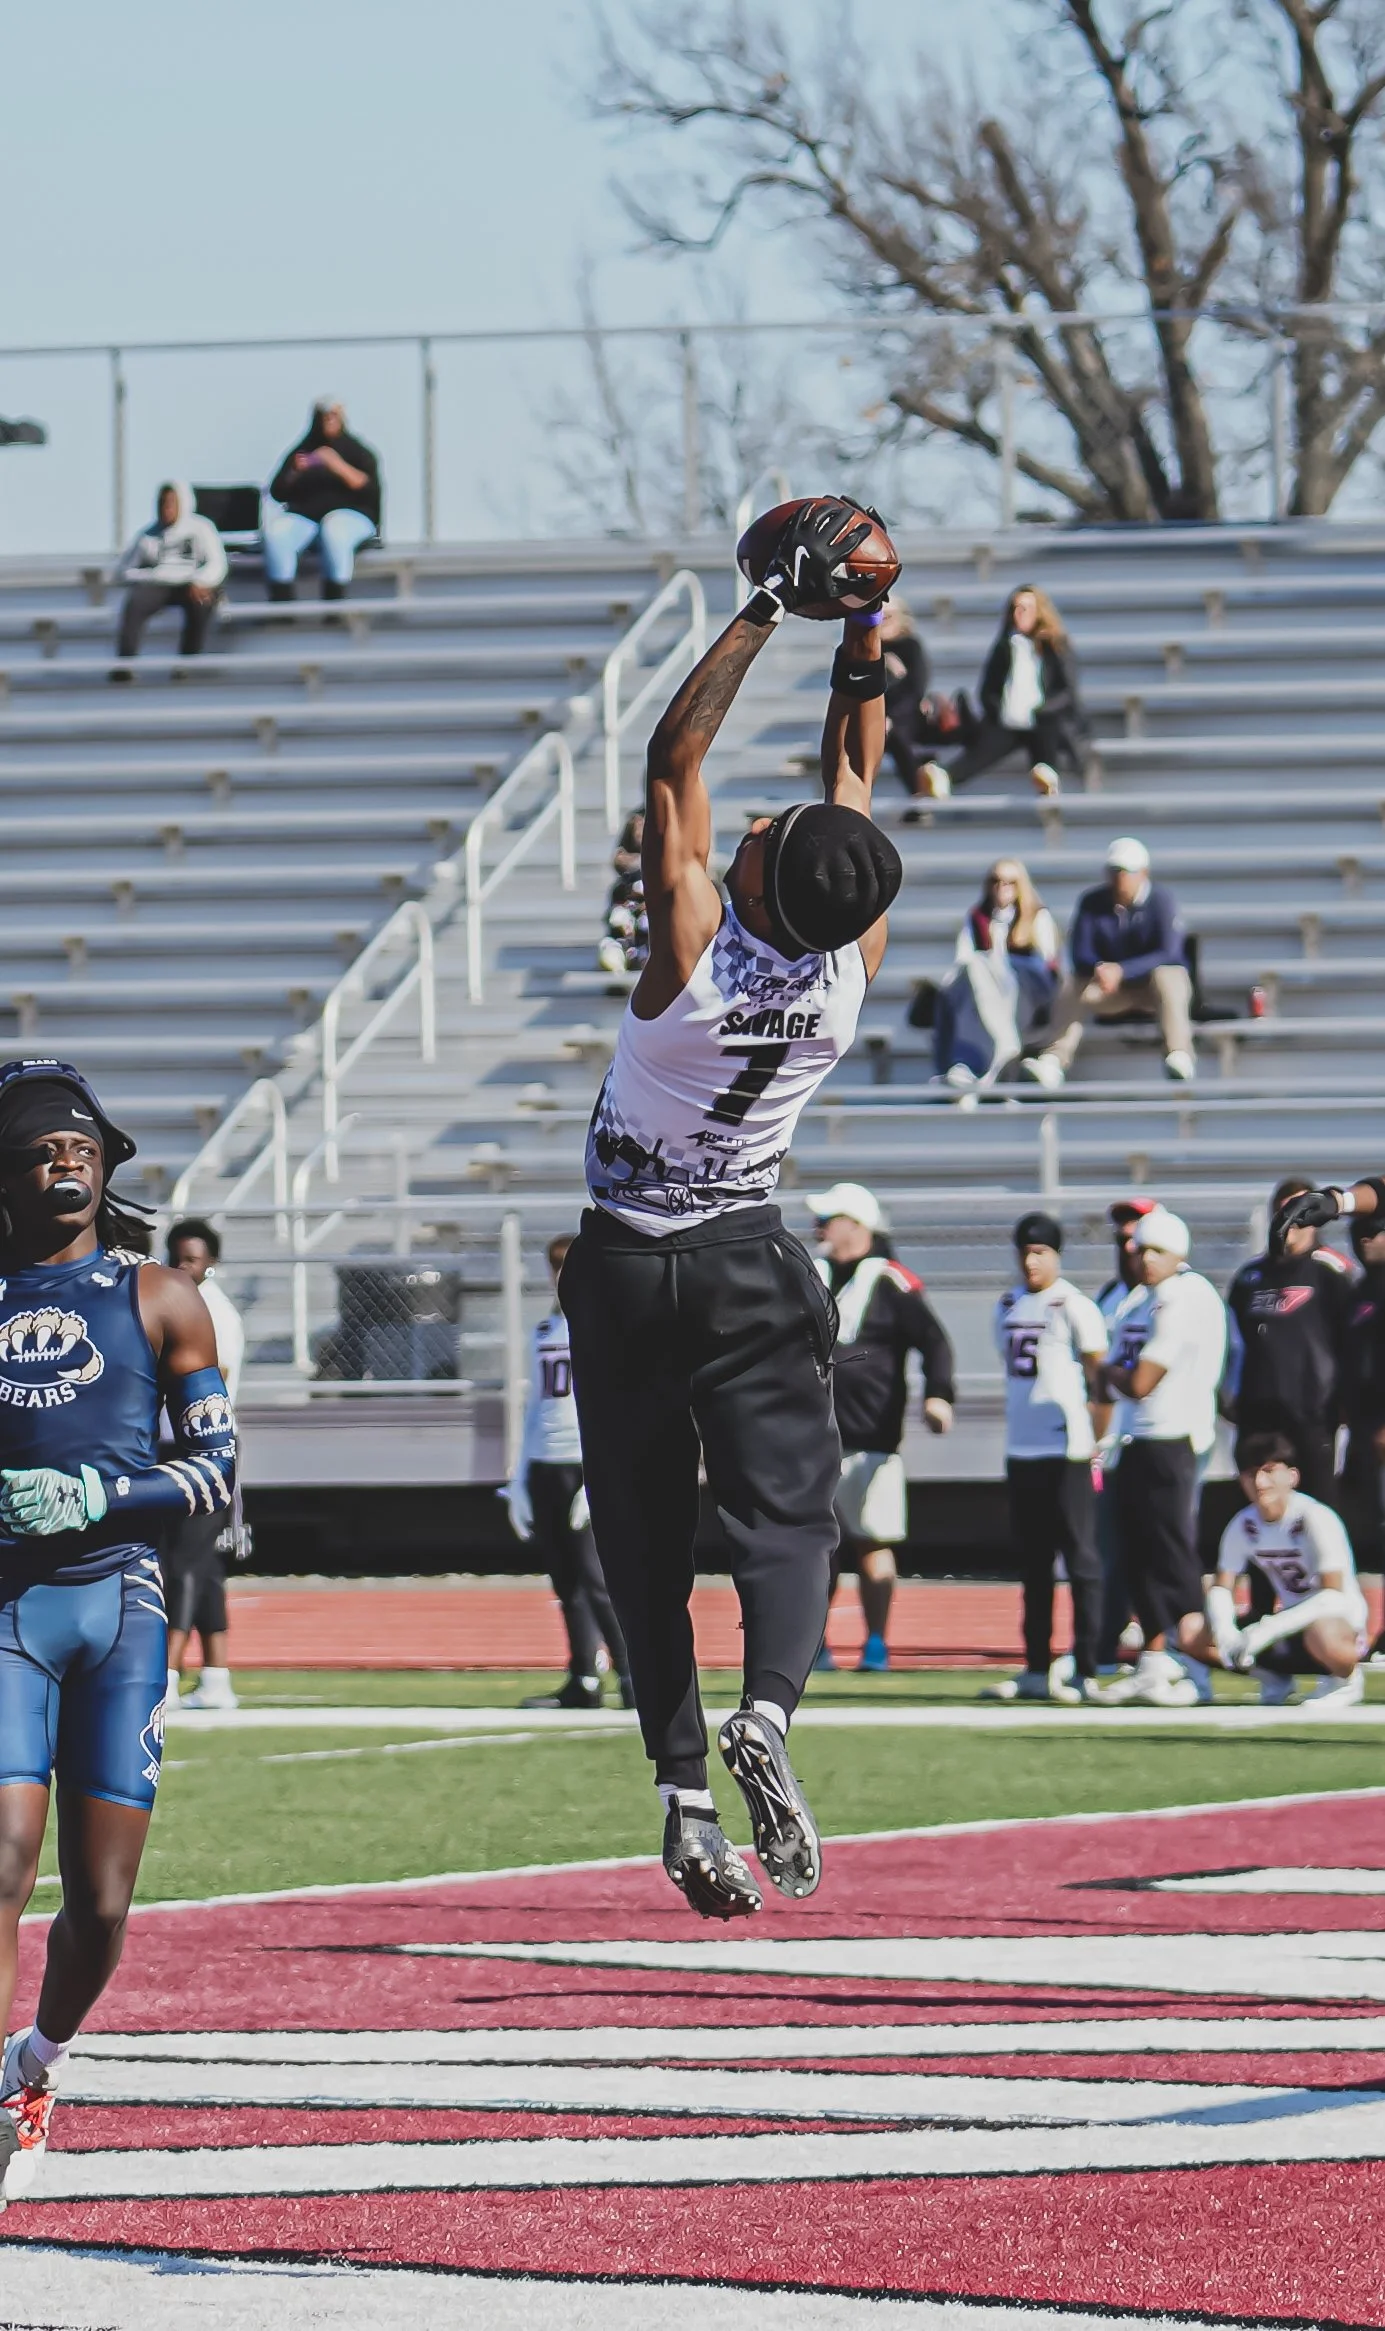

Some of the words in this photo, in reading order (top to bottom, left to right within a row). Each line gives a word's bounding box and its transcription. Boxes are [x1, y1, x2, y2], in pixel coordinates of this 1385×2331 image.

[719, 1008, 821, 1039] SAVAGE
[702, 1042, 791, 1127] 7
[0, 1382, 77, 1409] BEARS
[541, 1358, 572, 1398] 10
